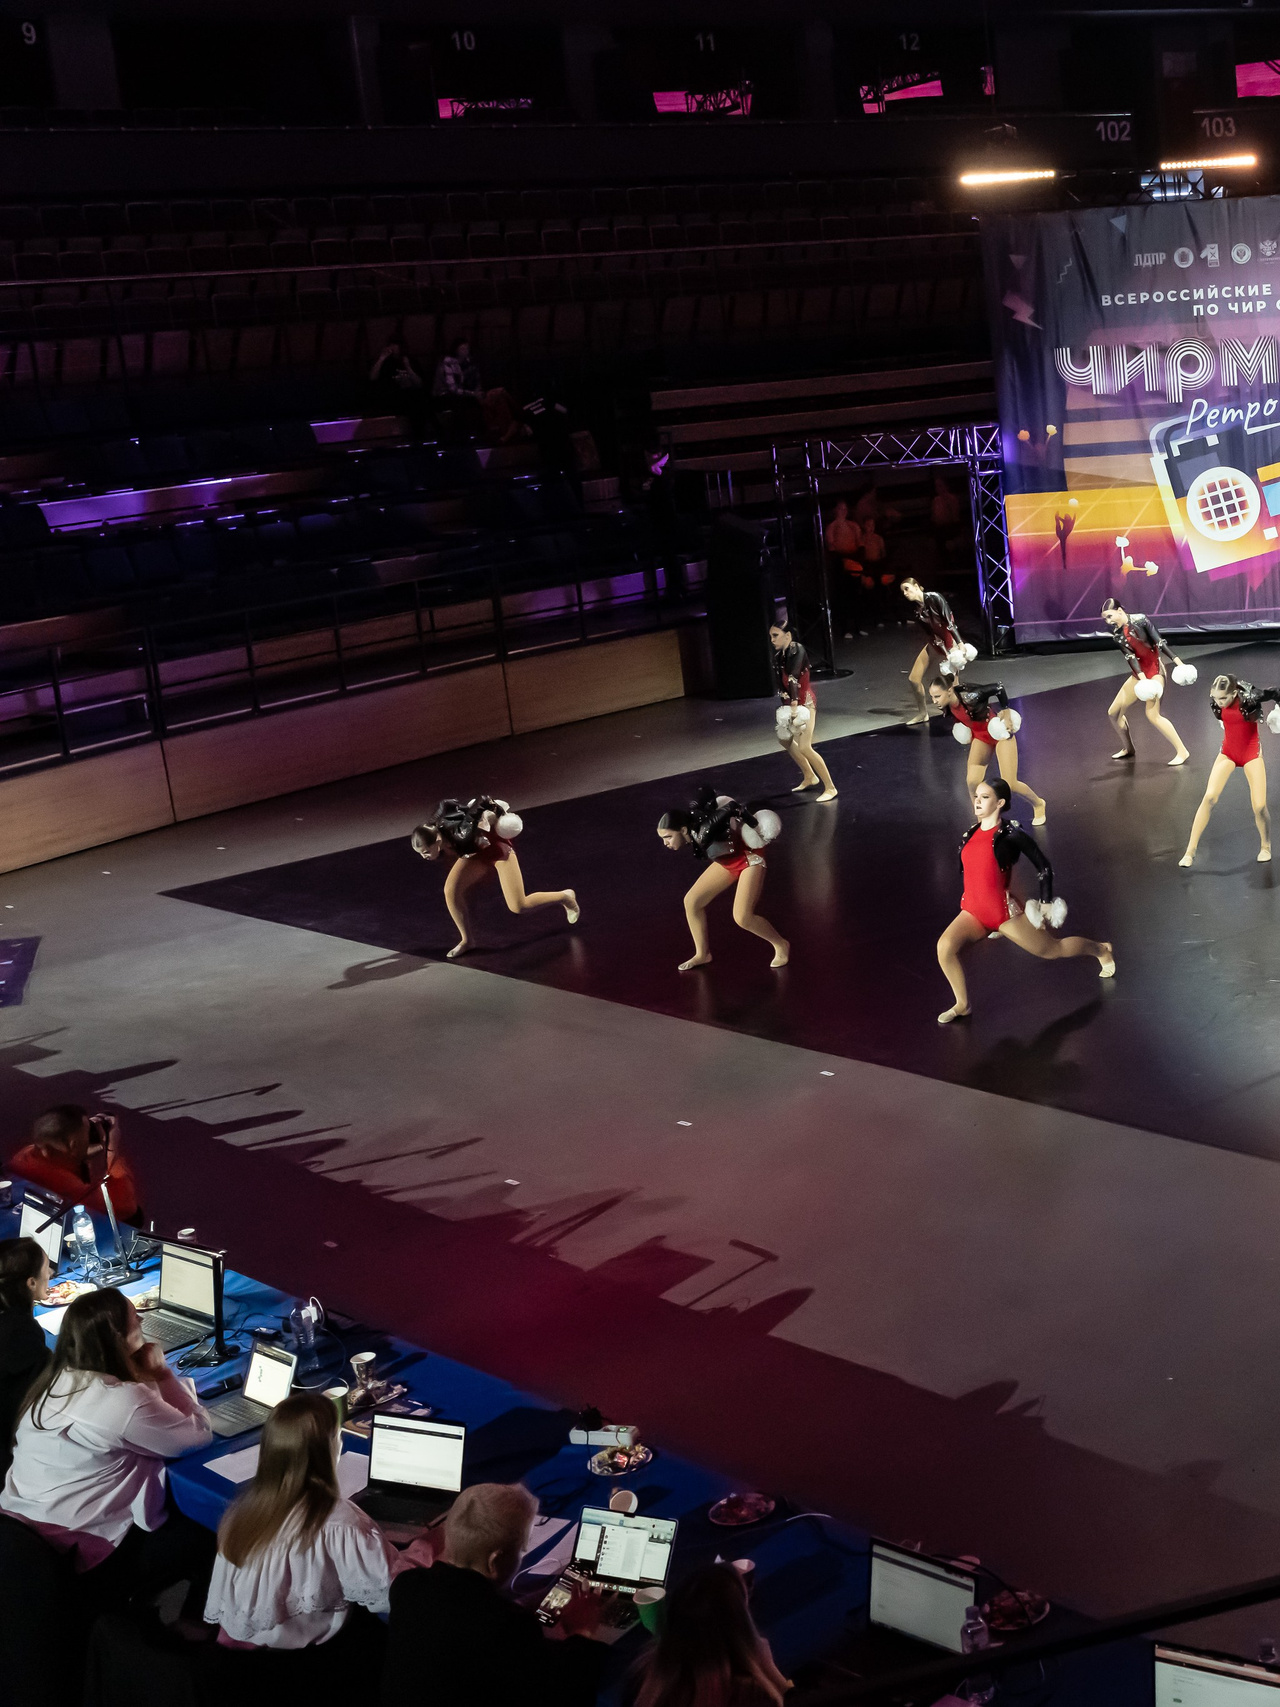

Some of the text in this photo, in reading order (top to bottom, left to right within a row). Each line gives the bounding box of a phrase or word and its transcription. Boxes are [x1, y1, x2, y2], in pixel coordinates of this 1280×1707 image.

[21, 21, 37, 45] 9
[451, 31, 476, 51] 10
[693, 32, 715, 52] 11
[899, 33, 920, 51] 12
[1095, 121, 1132, 142] 102
[1201, 117, 1236, 137] 103
[1133, 252, 1166, 268] ЛДПР
[1101, 283, 1272, 306] ВСЕРОССИЙСКИЕ
[1193, 304, 1219, 316] ПО
[1228, 300, 1266, 313] ЧИР
[1185, 398, 1279, 436] Ретро
